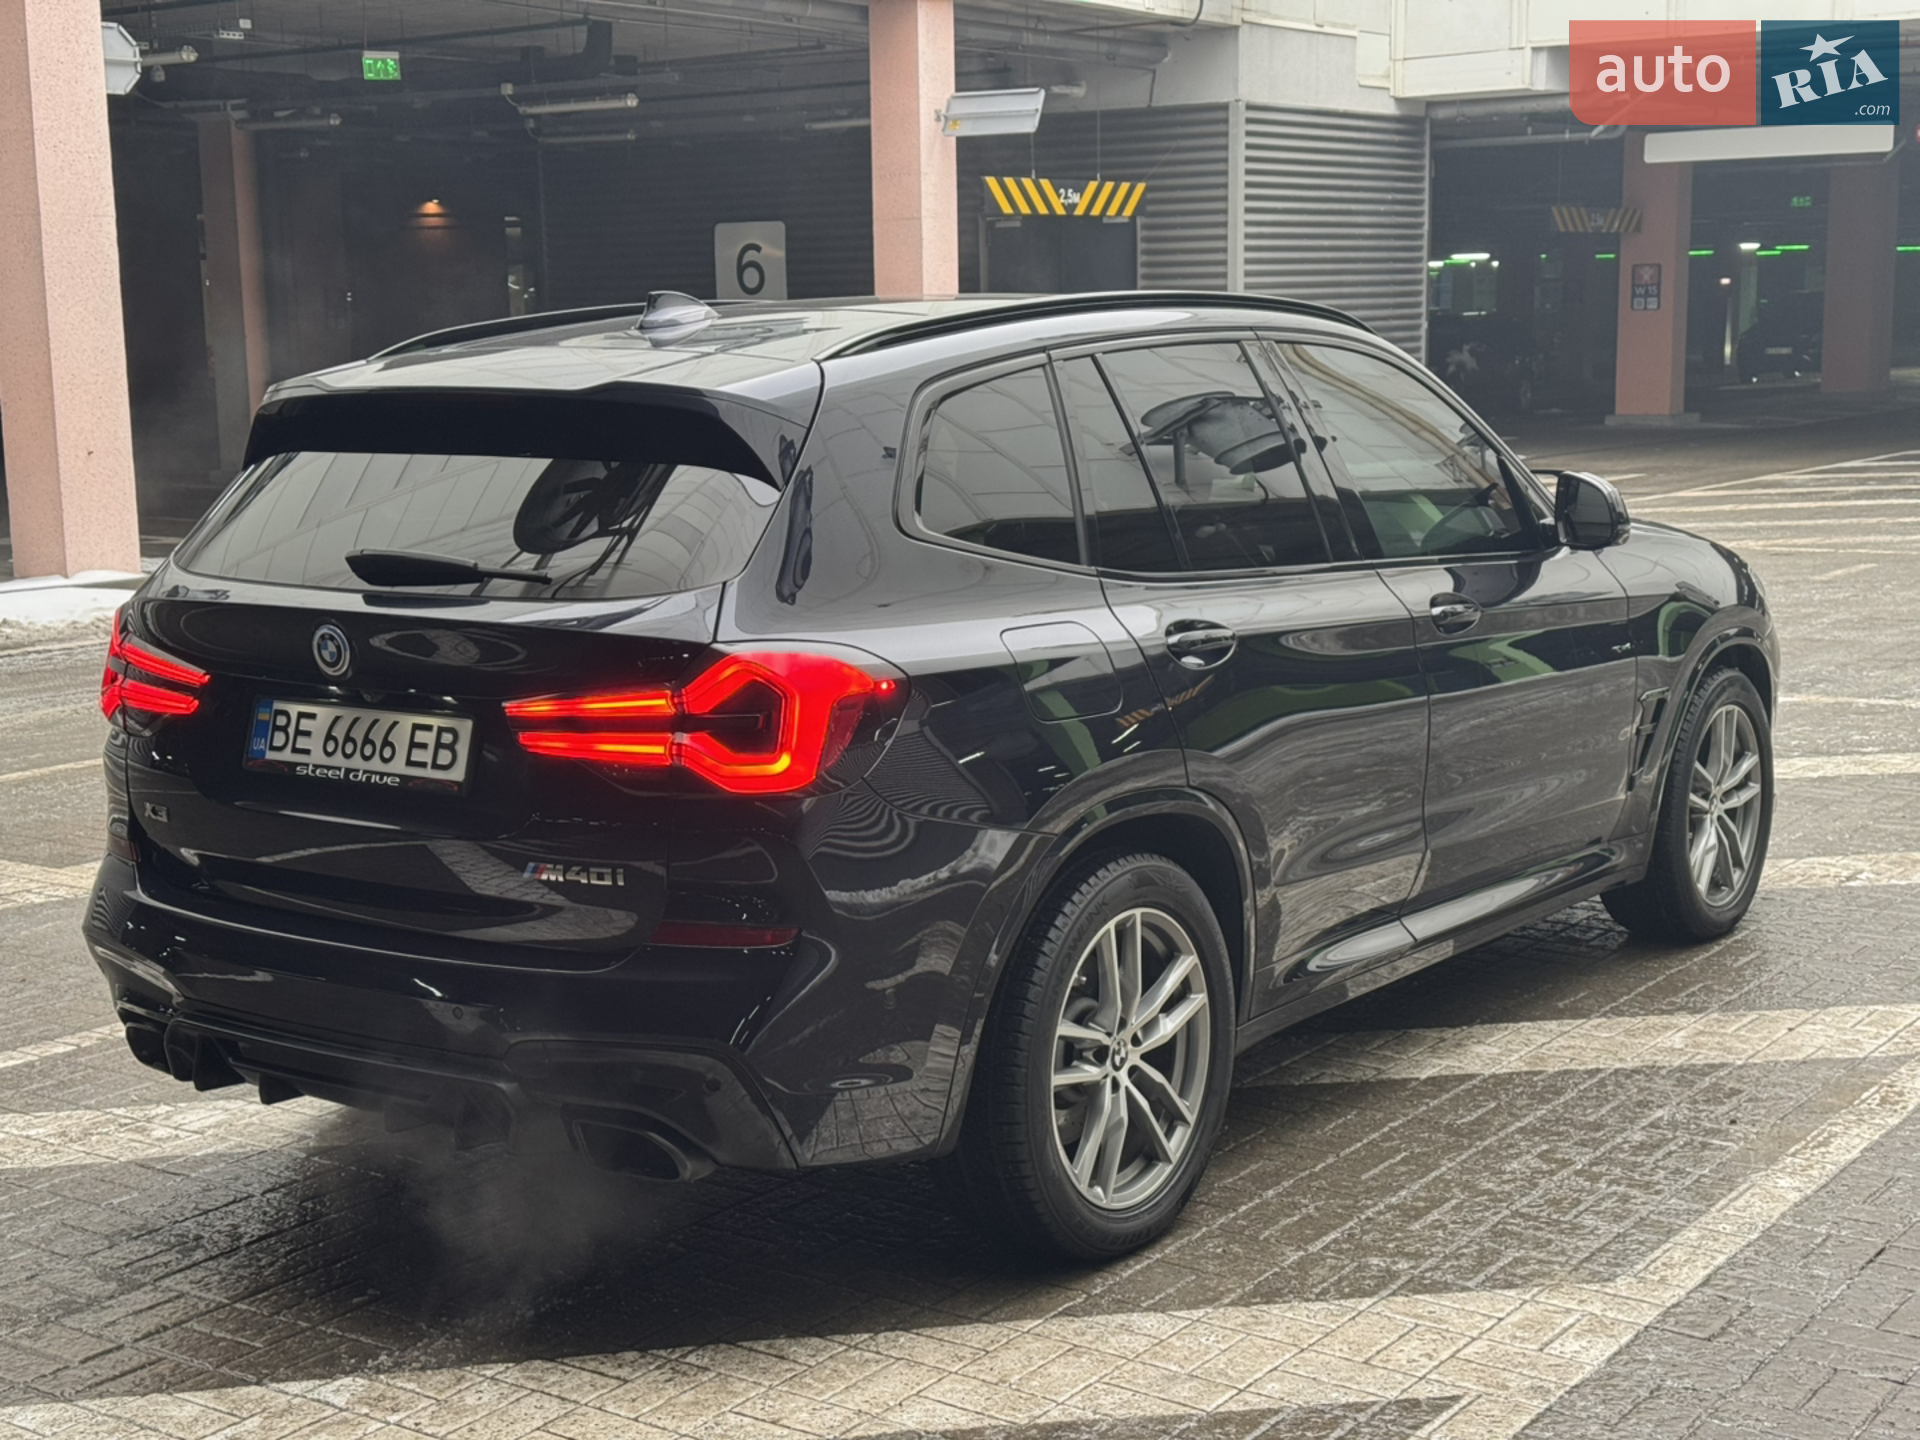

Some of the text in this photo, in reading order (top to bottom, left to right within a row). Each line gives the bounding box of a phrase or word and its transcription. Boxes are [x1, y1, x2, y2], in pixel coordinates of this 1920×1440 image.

[736, 242, 765, 296] 6
[252, 738, 266, 750] UA
[268, 709, 460, 771] BE 6666 EB
[295, 764, 401, 786] steel drive
